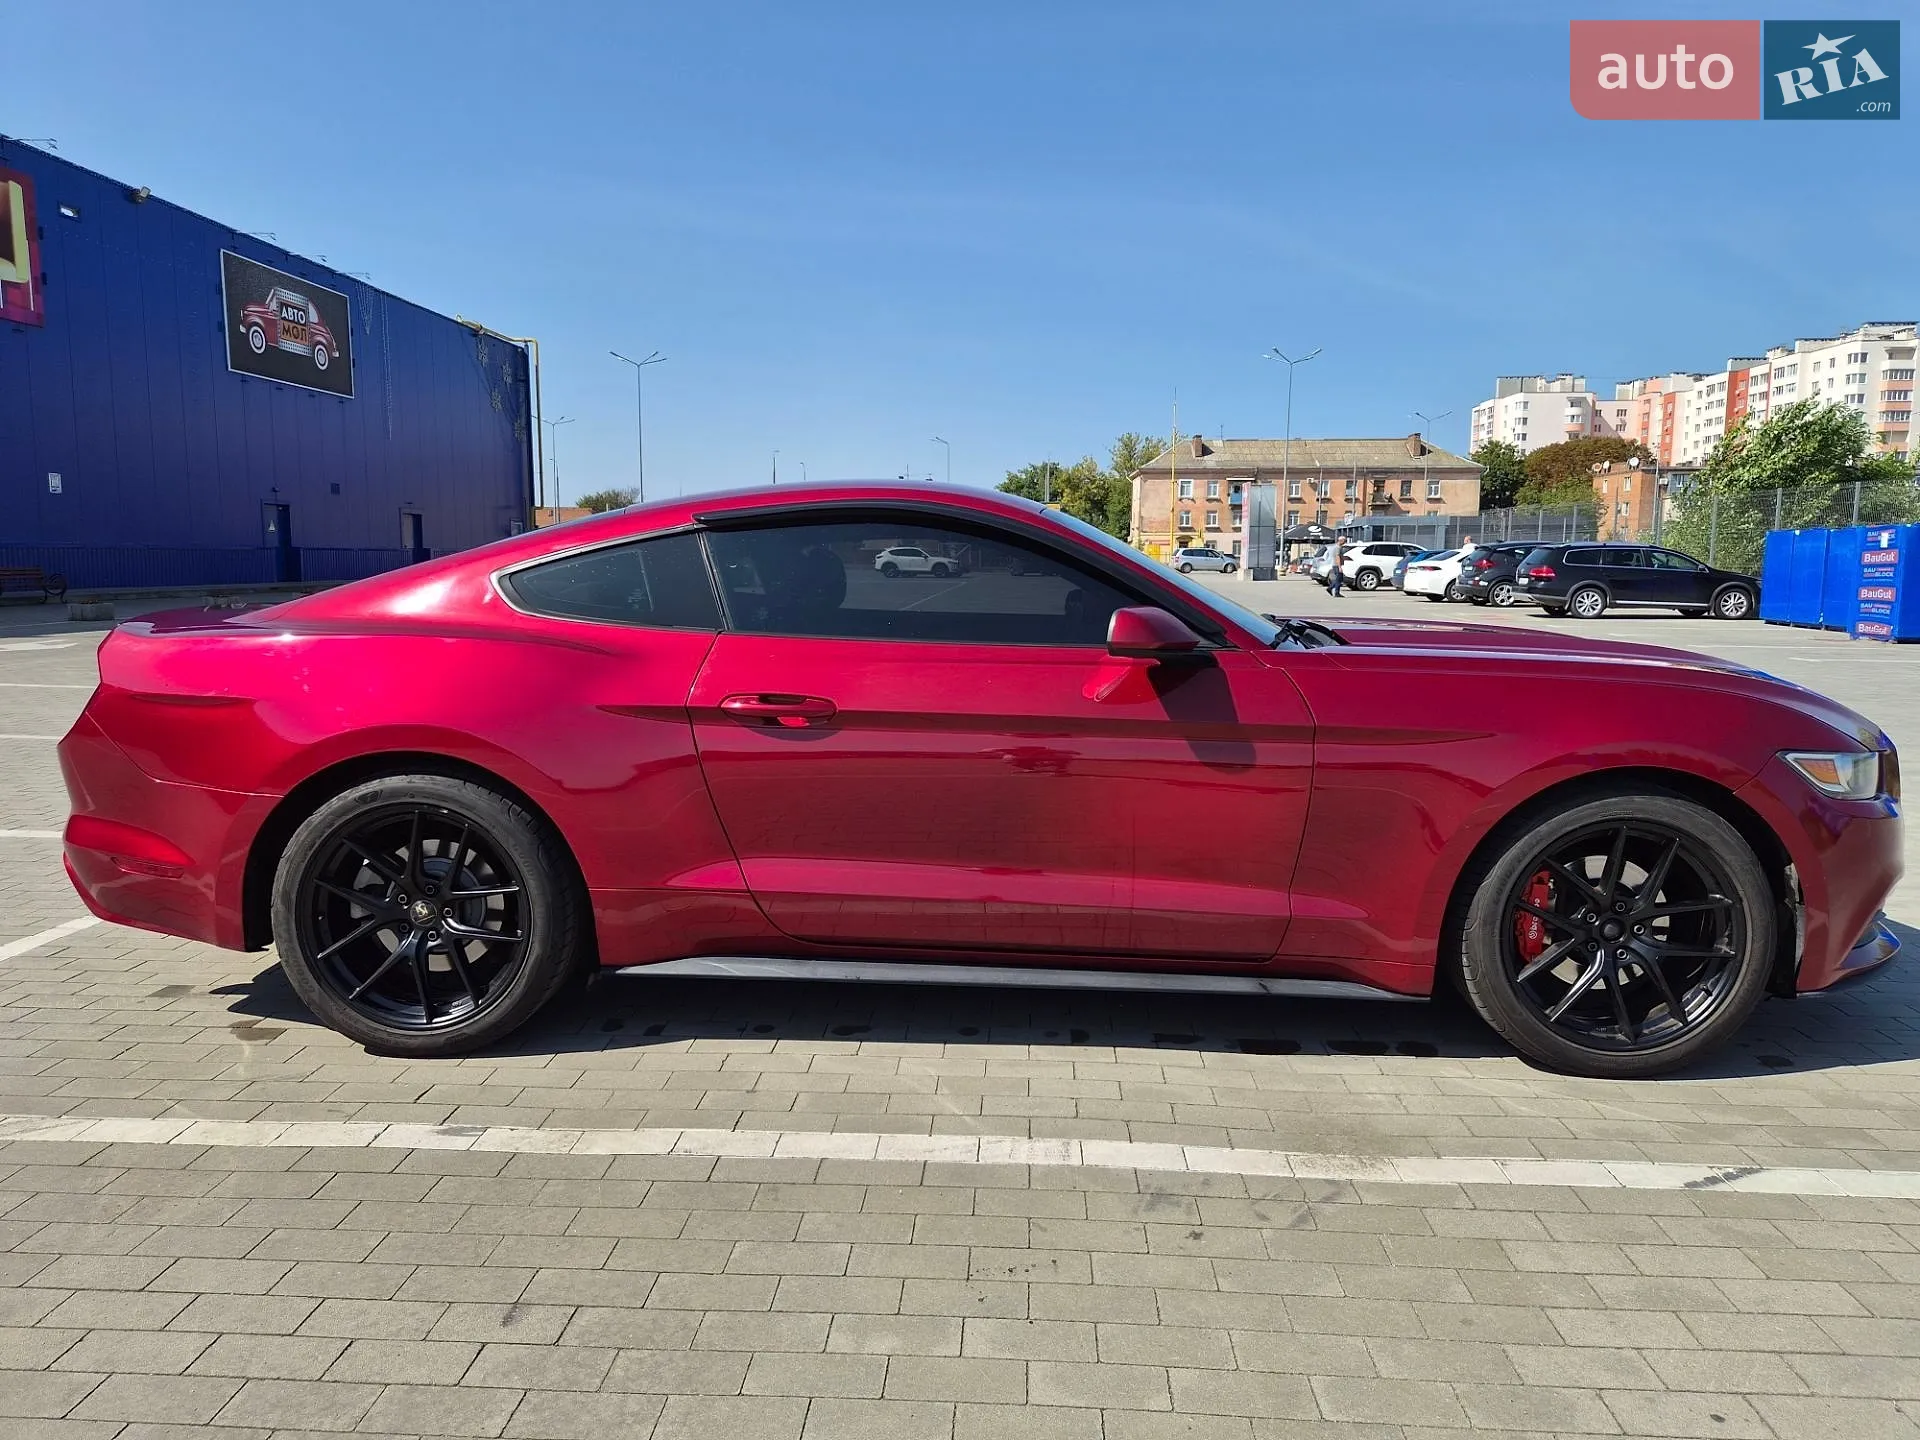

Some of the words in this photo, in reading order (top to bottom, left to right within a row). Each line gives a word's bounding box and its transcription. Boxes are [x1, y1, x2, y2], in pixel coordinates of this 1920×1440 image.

[281, 306, 306, 324] АВТО
[1863, 552, 1895, 562] BauGut
[1861, 589, 1892, 600] BauGut
